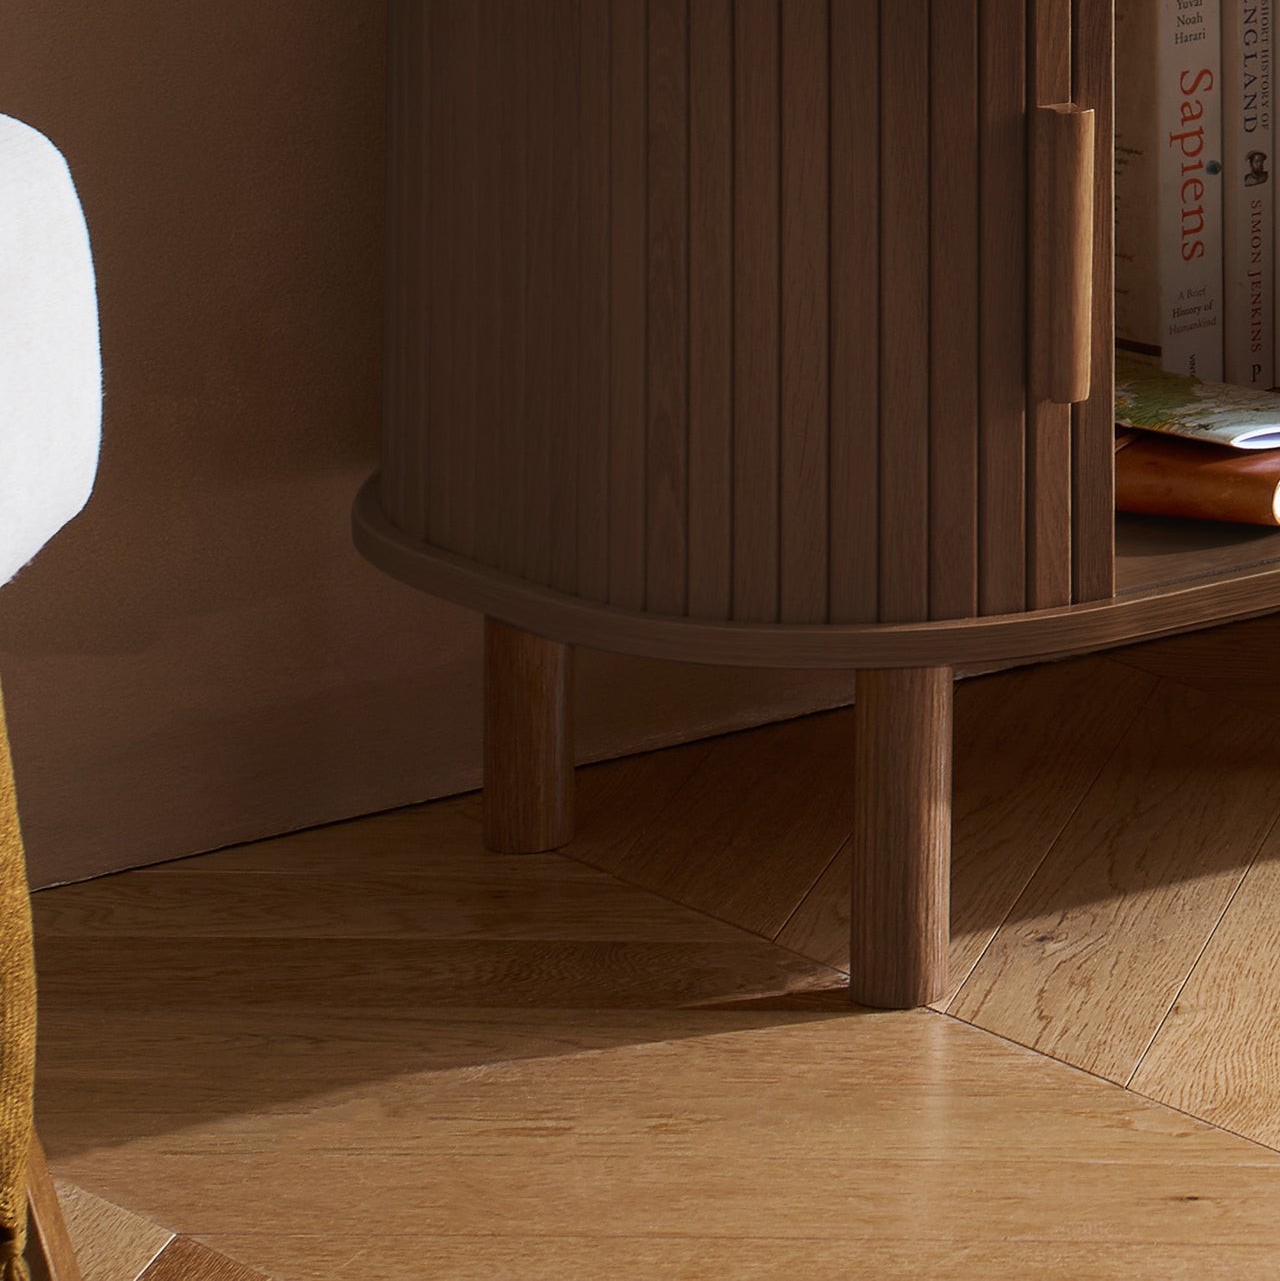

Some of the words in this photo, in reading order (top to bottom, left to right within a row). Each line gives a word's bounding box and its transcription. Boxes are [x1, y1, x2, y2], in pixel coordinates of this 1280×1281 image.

[1176, 12, 1203, 27] Noah
[1174, 28, 1206, 44] Harari
[1260, 49, 1269, 108] HISTORY
[1261, 113, 1269, 131] OF
[1169, 68, 1214, 261] Sapiens
[1250, 200, 1262, 263] SIMON
[1178, 290, 1185, 301] A
[1186, 286, 1206, 298] Brief
[1172, 303, 1202, 319] History
[1203, 299, 1214, 312] of
[1248, 270, 1262, 353] JENKINS
[1169, 316, 1217, 336] Humankind
